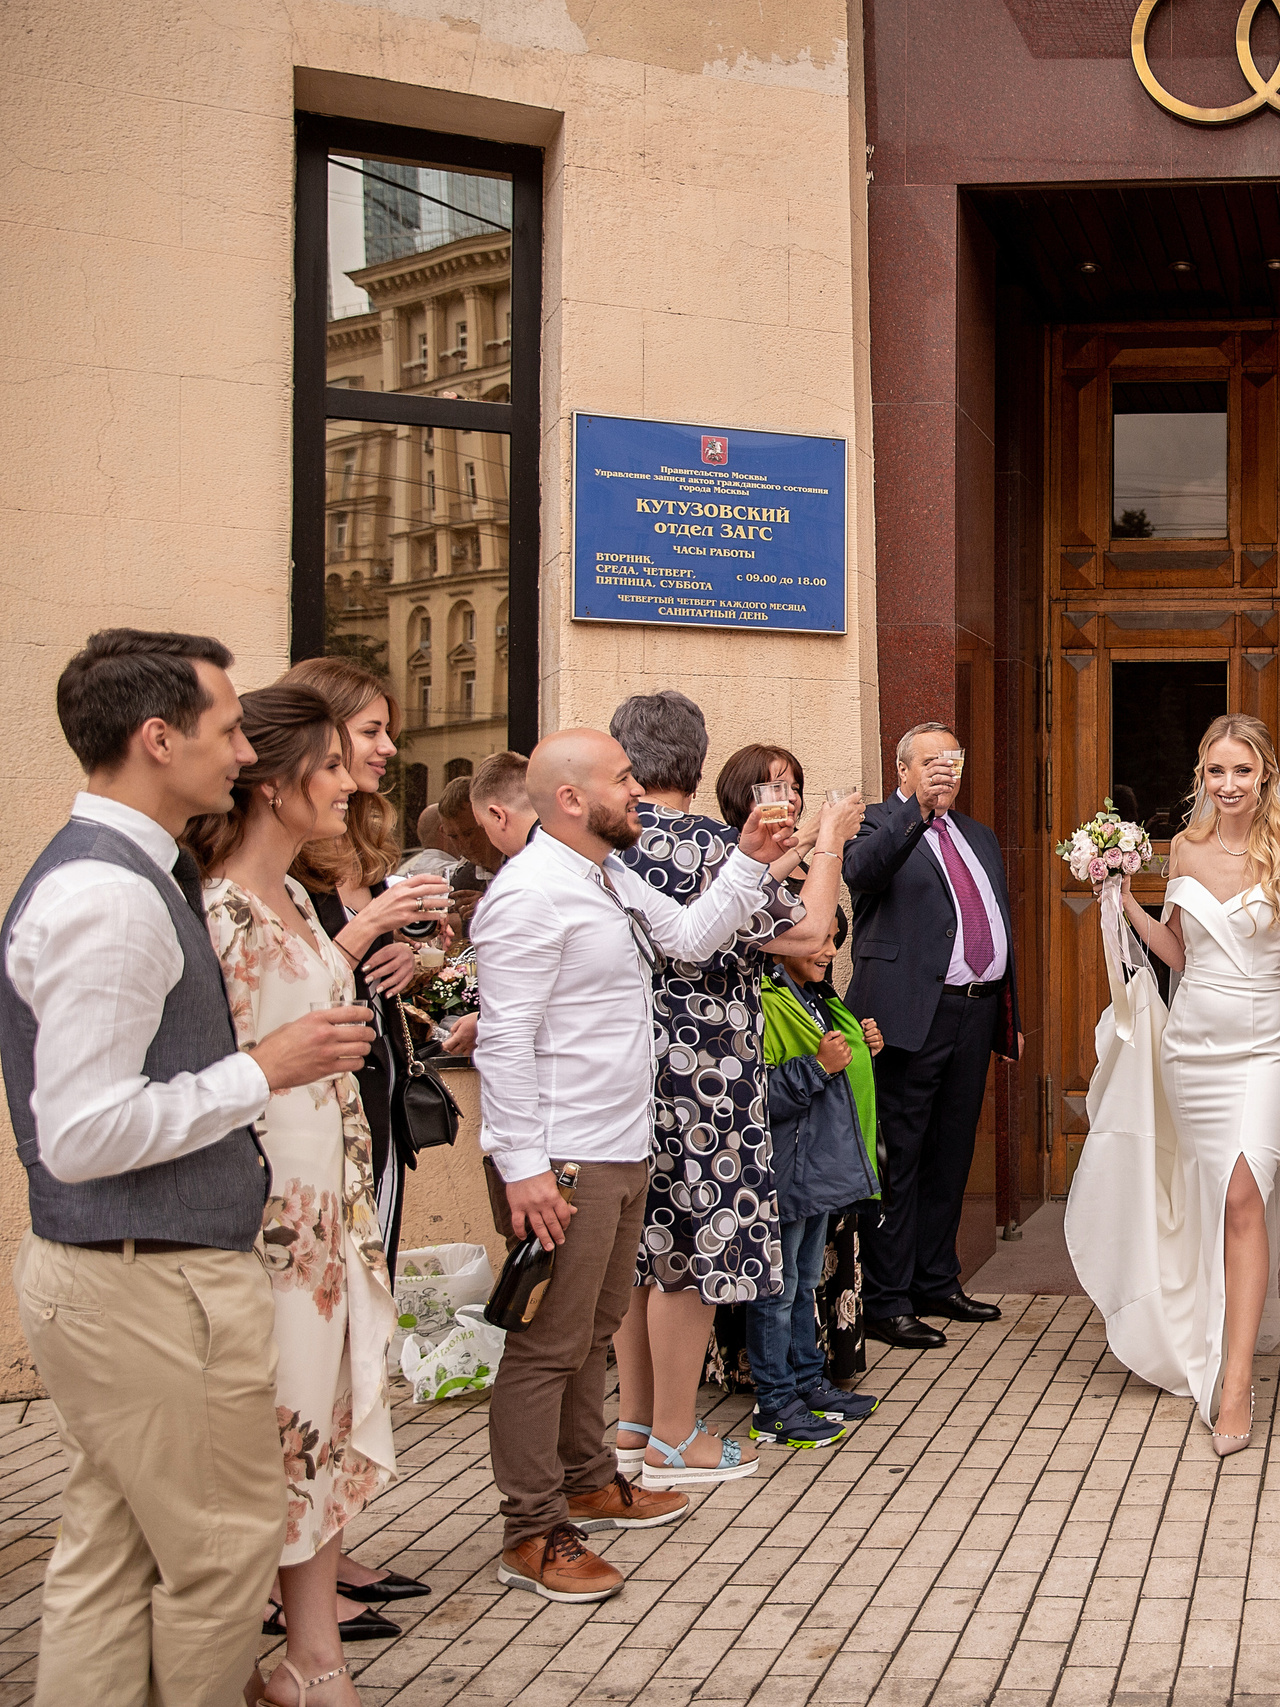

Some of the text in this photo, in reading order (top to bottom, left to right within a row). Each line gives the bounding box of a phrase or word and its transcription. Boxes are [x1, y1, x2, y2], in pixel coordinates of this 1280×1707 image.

[660, 465, 767, 481] Правительство Москвы
[594, 468, 829, 495] Управление записи актов гражданского состояния
[679, 484, 750, 496] города Москвы
[636, 498, 790, 523] КУТУЗОВСКИЙ
[654, 522, 773, 541] отдел ЗАГС
[596, 552, 654, 565] ВТОРНИК,
[673, 545, 755, 559] ЧАСЫ РАБОТЫ
[596, 564, 696, 579] СРЕДА, ЧЕТВЕРГ,
[596, 576, 713, 591] ПЯТНИЦА, СУББОТА
[745, 573, 777, 583] 09.00
[779, 577, 794, 585] до
[797, 577, 827, 587] 18.00
[617, 594, 807, 612] ЧЕТВЕРТЫЙ ЧЕТВЕРГ КАЖДОГО МЕСЯЦА
[657, 606, 769, 621] САНИТАРНЫЙ ДЕНЬ
